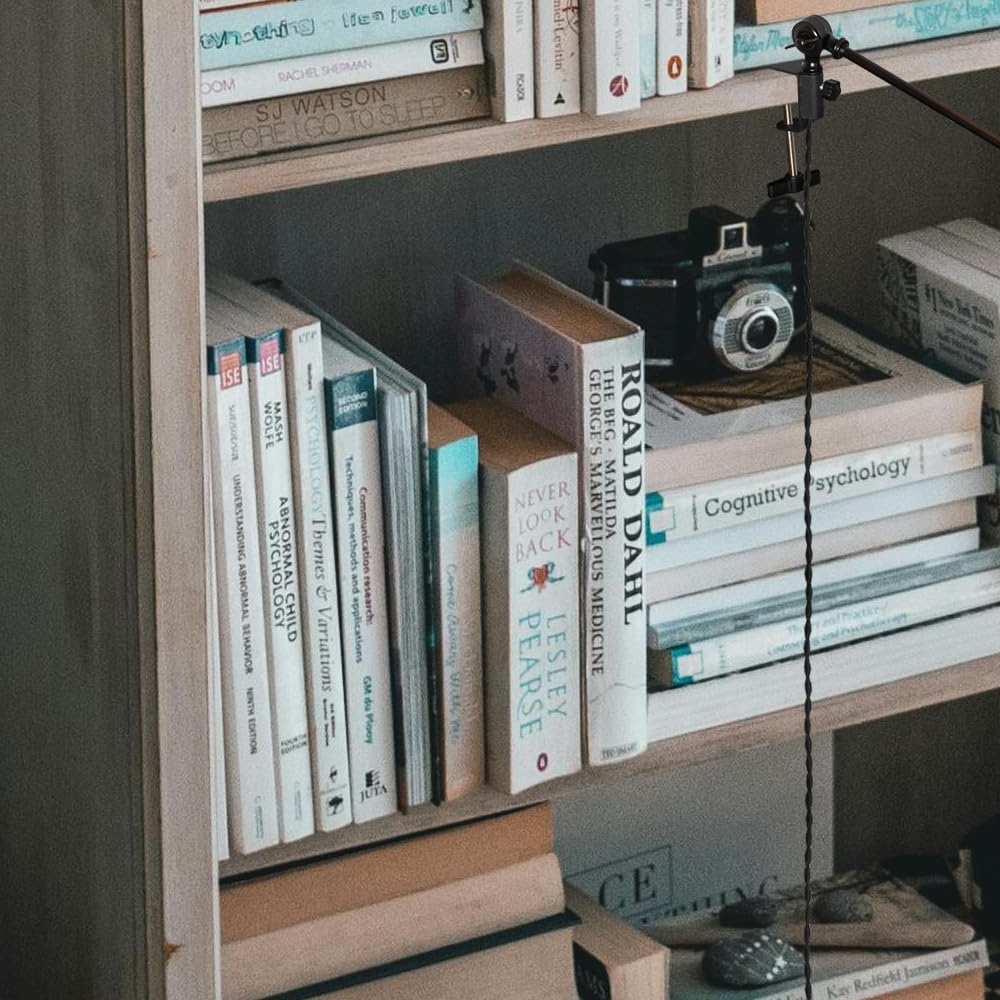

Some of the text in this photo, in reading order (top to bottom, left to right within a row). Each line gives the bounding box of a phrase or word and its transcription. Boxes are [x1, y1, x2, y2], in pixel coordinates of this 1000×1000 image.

[277, 58, 373, 82] RACHEL SHERMAN
[291, 85, 386, 117] WATSON
[201, 95, 446, 157] BEFORE GO TO SLEEP
[264, 401, 275, 450] WOLFE
[273, 401, 284, 443] MASH
[603, 366, 618, 540] THE BFG MATILDA
[514, 480, 571, 513] NEVER
[518, 503, 566, 534] LOOK
[589, 368, 605, 676] GEORGE'S MARVELLOUS MEDICINE
[621, 361, 644, 626] ROALD DAHL
[704, 482, 799, 517] Cognitive
[232, 474, 254, 675] UNDERSTANDING ABNORMAL BEHAVIOR
[268, 521, 286, 628] PSYCHOLOGY
[279, 496, 299, 643] ABNORMAL CHILD
[311, 513, 328, 580] Themes
[344, 456, 366, 663] Techniques, methods and applications
[358, 486, 376, 625] Communication research:
[515, 527, 573, 563] BACK
[318, 606, 333, 692] Variations
[517, 609, 543, 740] PEARSE
[546, 613, 568, 720] LESLEY
[246, 687, 259, 755] NINTH EDITION
[363, 675, 375, 712] GM du
[598, 862, 657, 911] CE
[853, 968, 902, 994] Redfield
